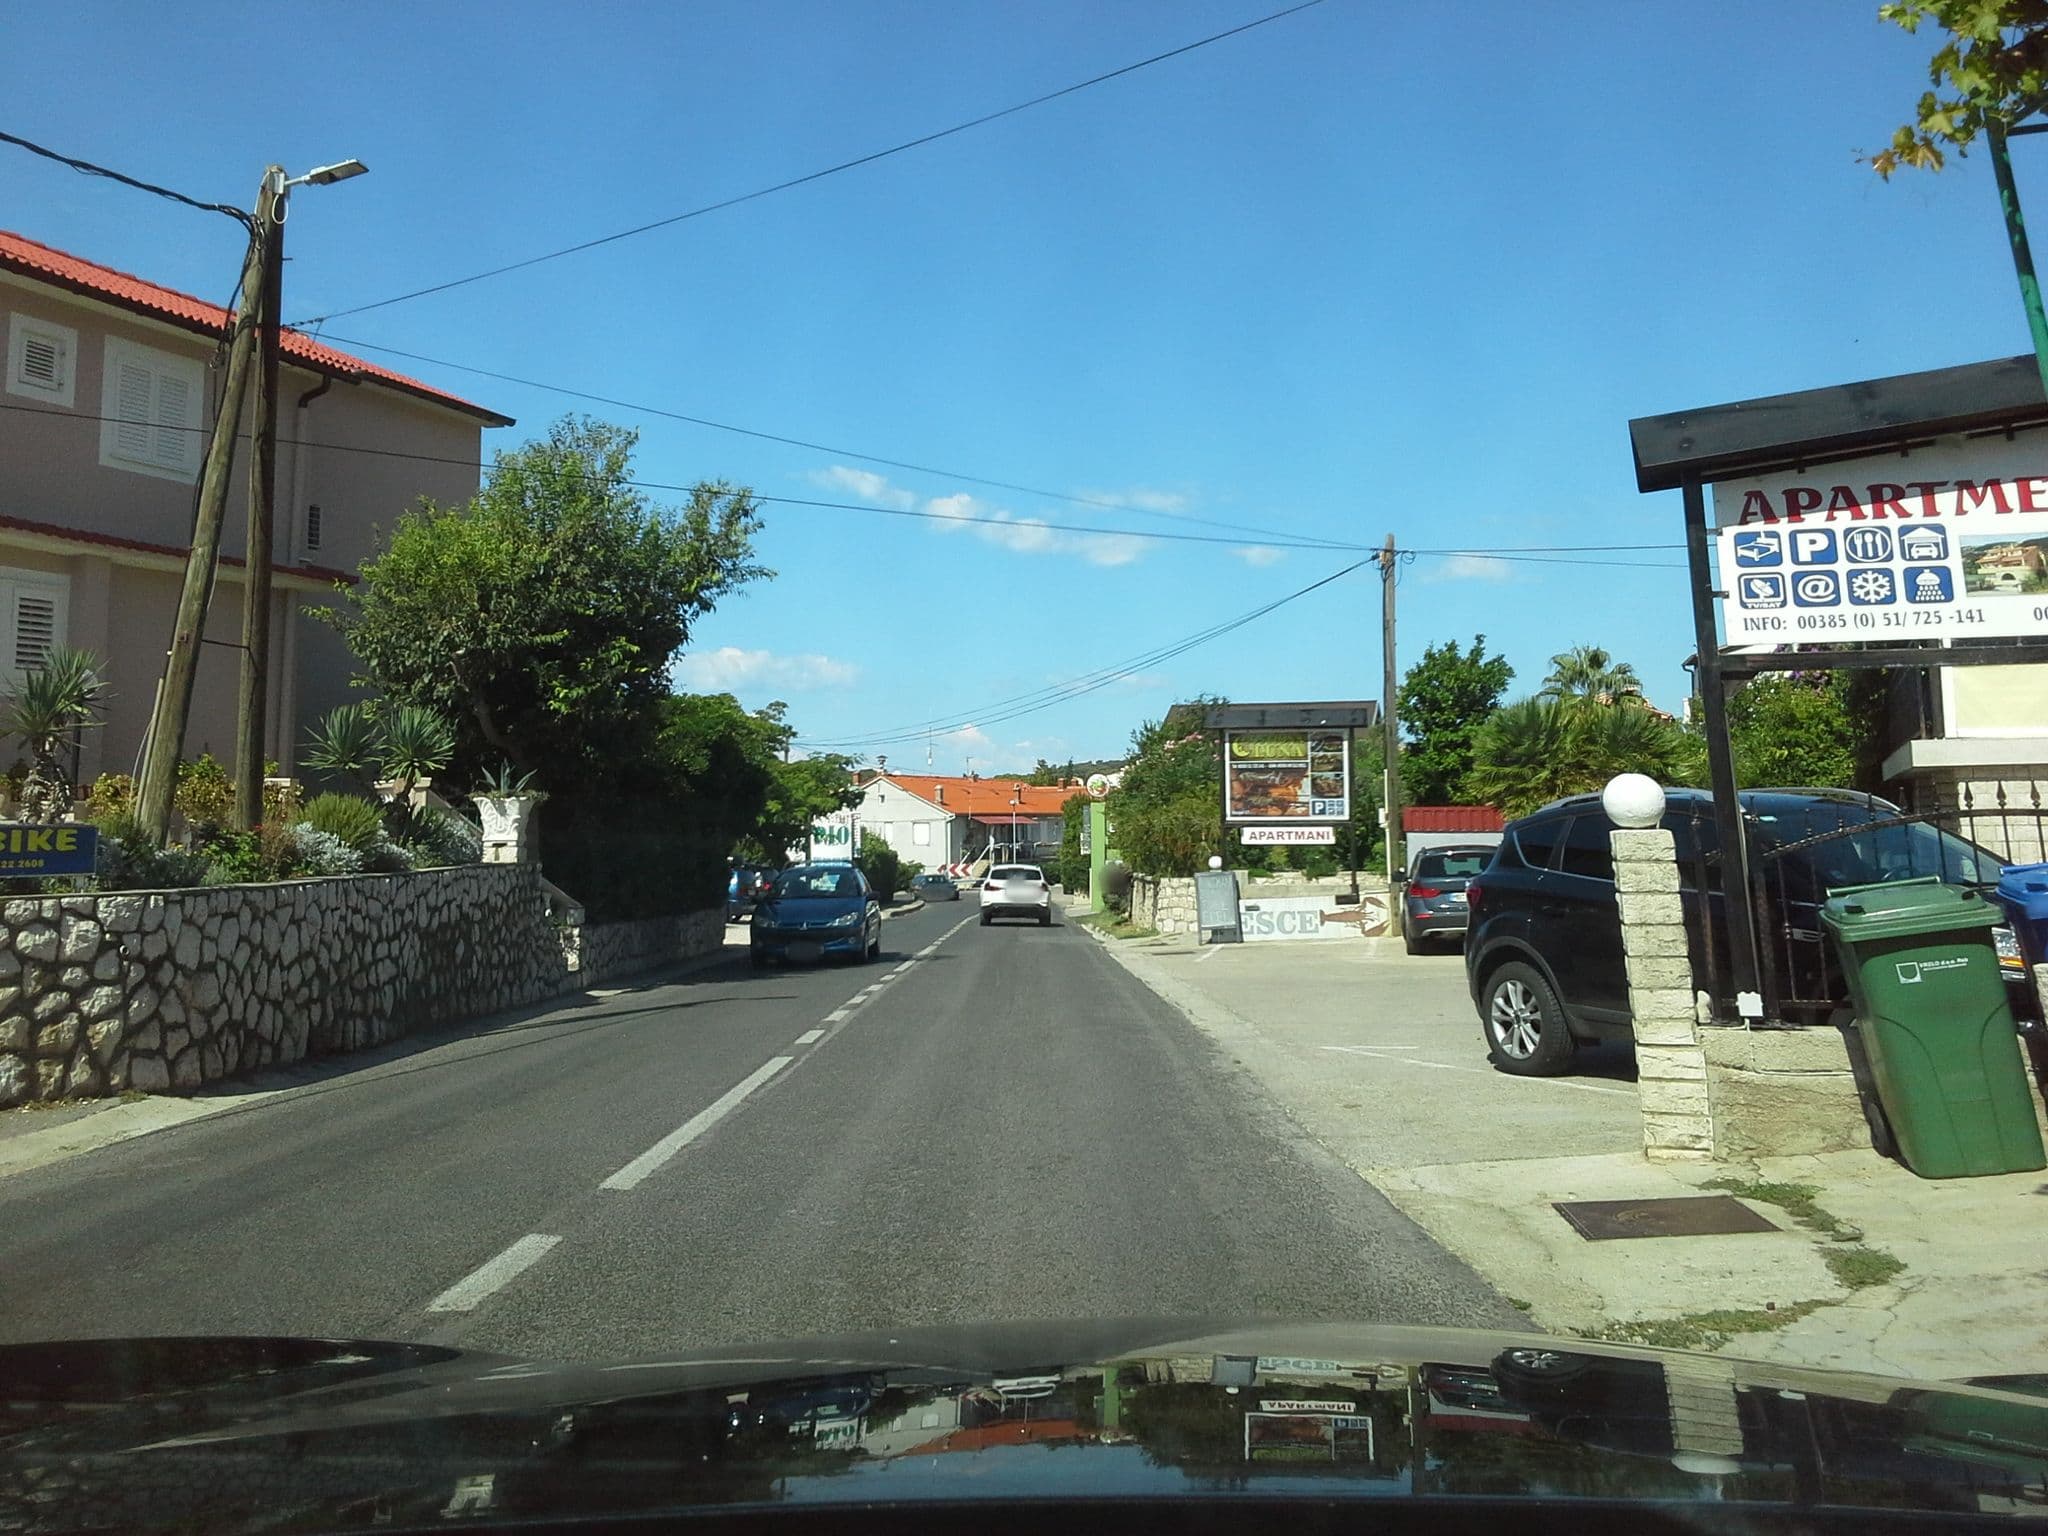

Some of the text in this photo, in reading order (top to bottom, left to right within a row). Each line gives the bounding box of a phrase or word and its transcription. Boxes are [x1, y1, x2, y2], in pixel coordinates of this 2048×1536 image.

[1738, 476, 2048, 525] APARTME
[1743, 616, 1787, 631] INFO:
[1797, 613, 1847, 629] 00385
[1853, 612, 1875, 629] (0)
[1882, 611, 1907, 627] 51/
[1912, 610, 1943, 625] 725
[1948, 608, 1986, 624] -141
[1248, 831, 1330, 841] APARTMANI
